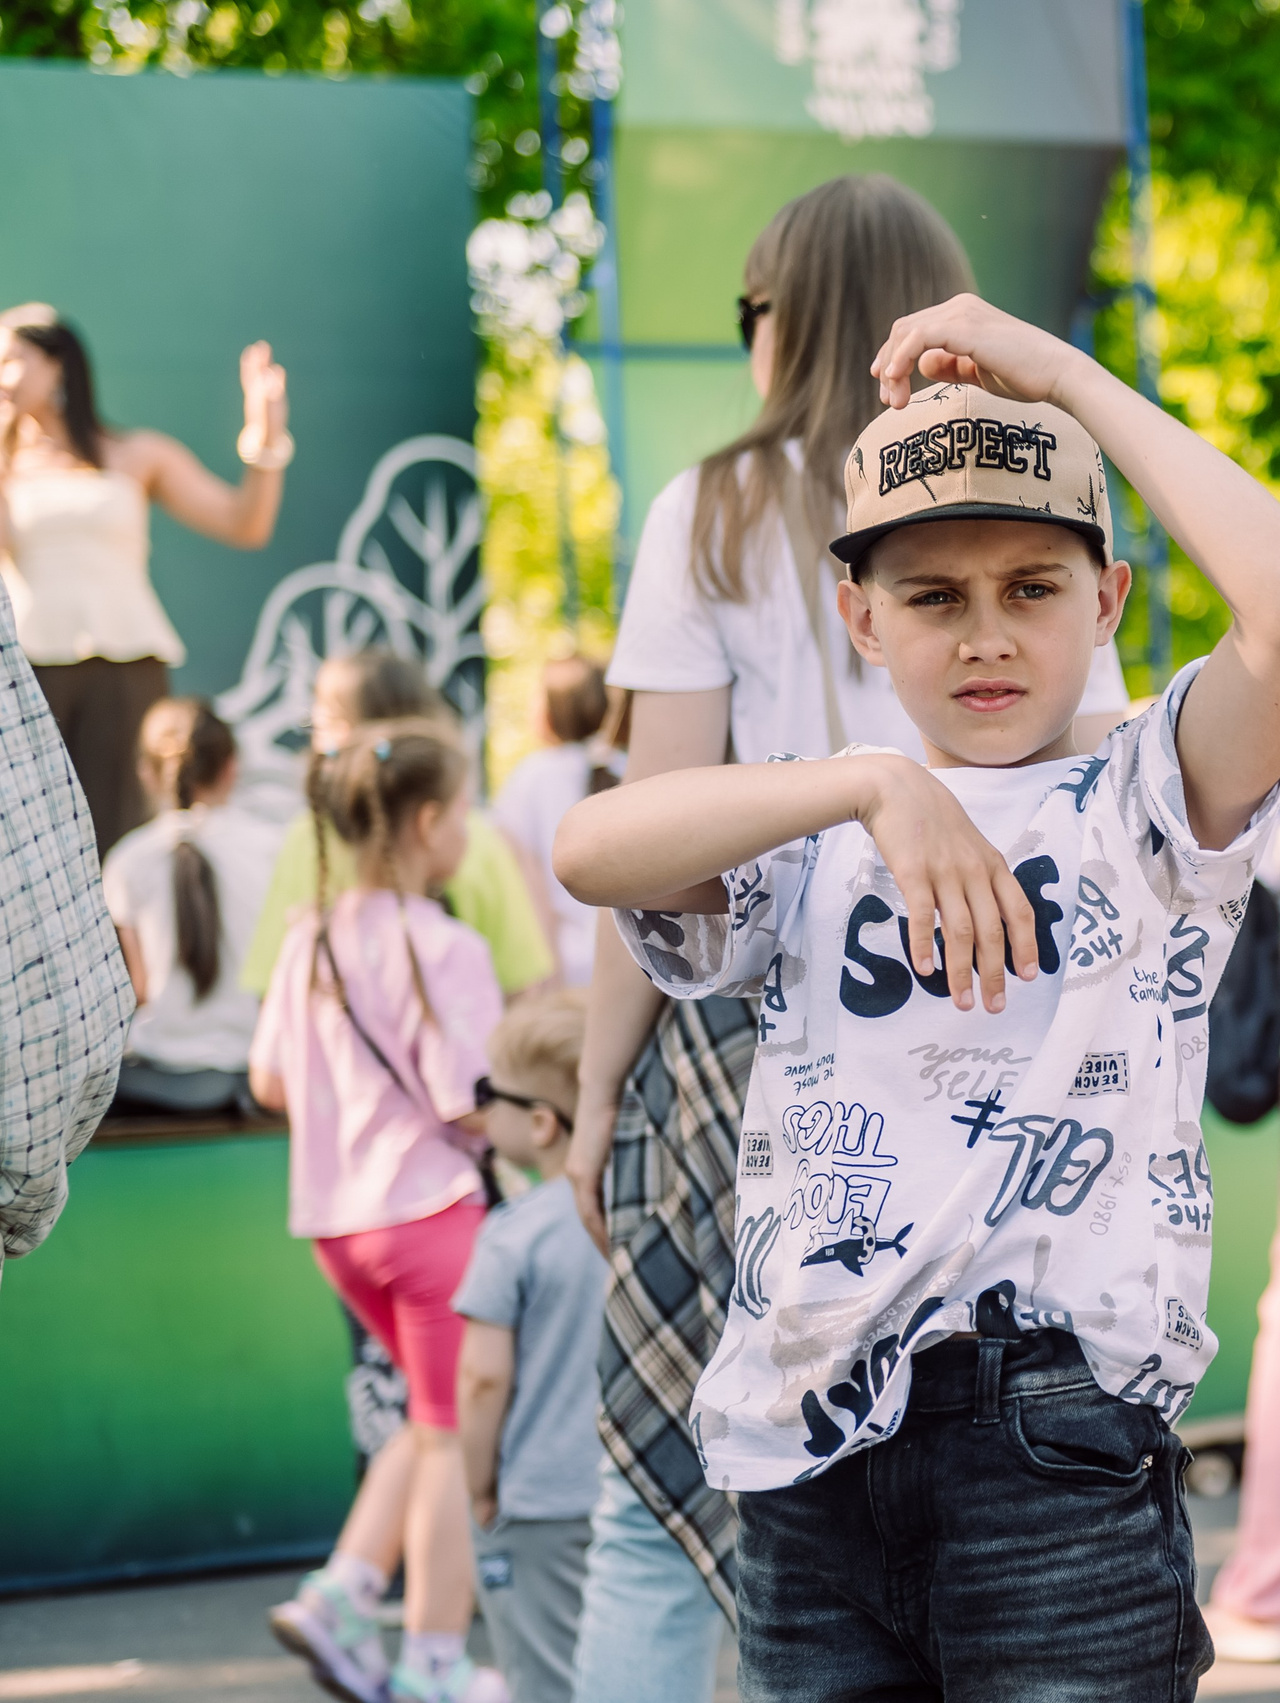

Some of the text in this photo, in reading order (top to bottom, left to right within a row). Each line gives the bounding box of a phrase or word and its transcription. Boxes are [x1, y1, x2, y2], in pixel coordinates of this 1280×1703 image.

[878, 417, 1057, 496] RESPECT
[1133, 966, 1159, 985] the
[1074, 1073, 1119, 1089] BEACH
[1088, 1192, 1118, 1236] 1980
[1166, 1202, 1212, 1233] the
